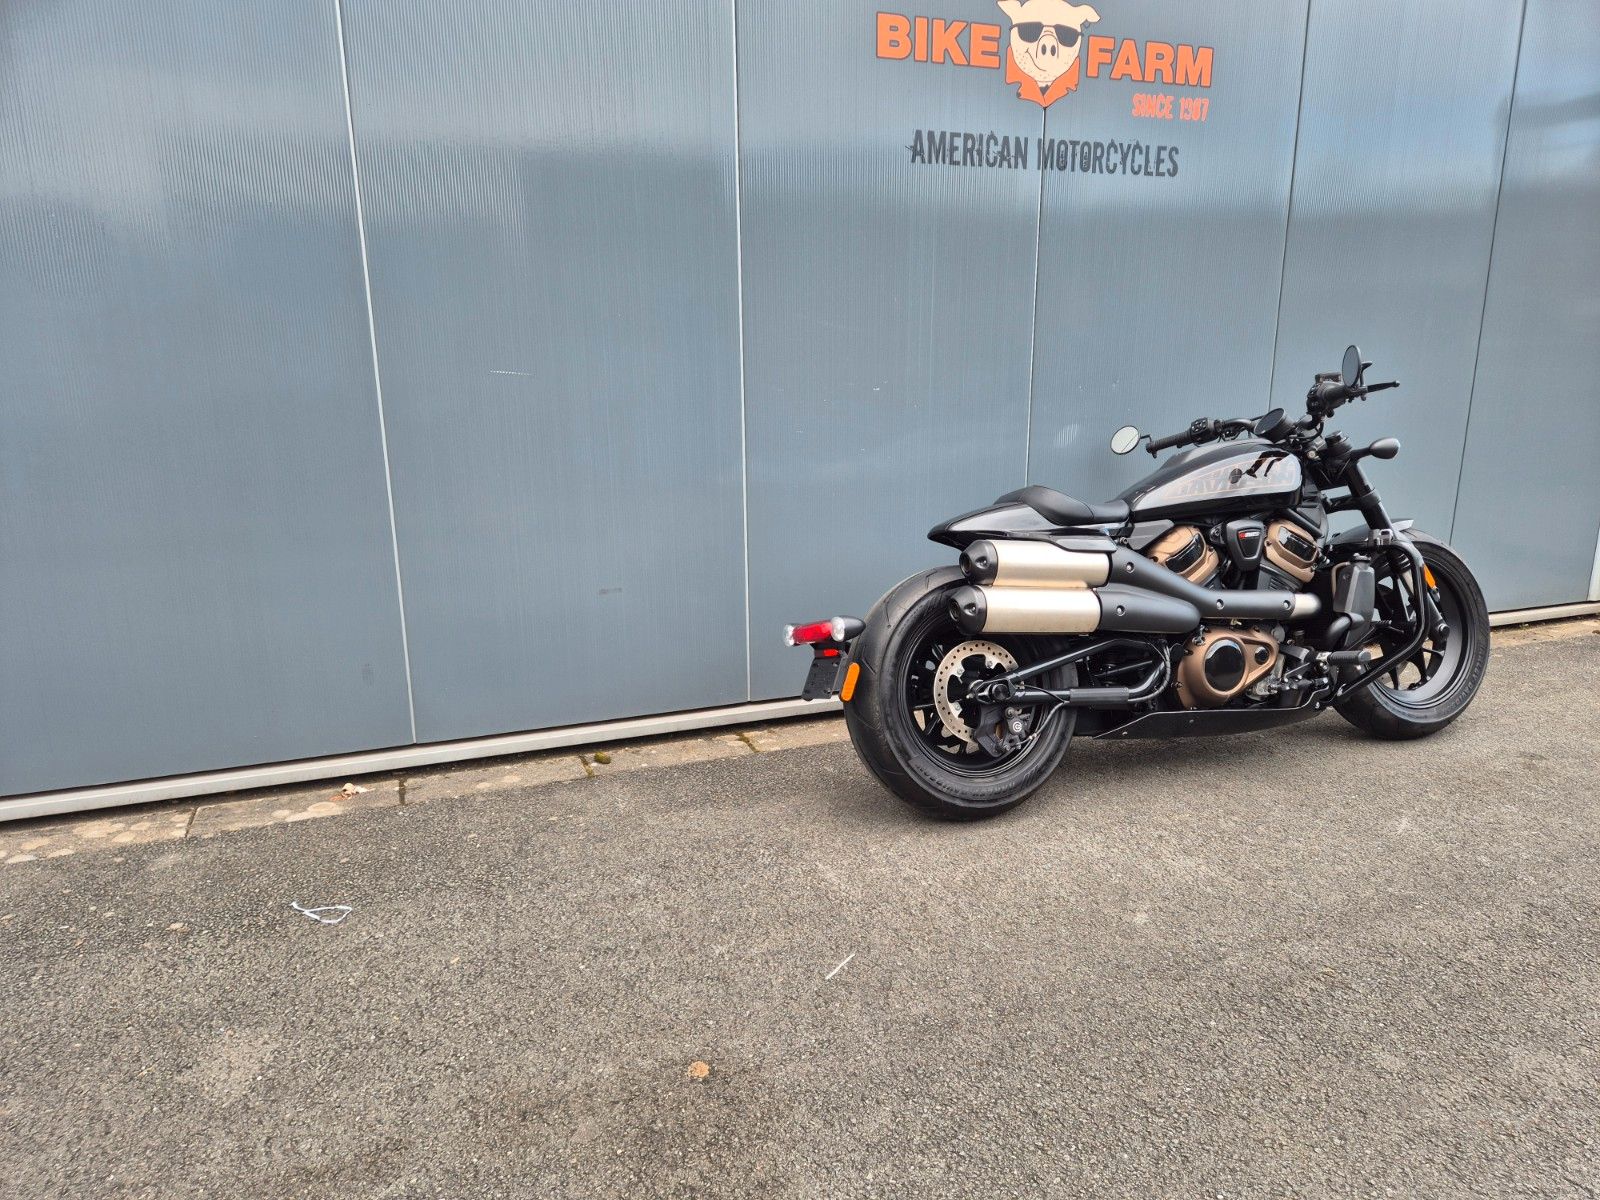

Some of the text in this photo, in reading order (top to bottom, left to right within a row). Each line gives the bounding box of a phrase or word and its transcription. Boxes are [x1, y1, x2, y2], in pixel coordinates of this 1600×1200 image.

[876, 11, 1214, 88] BIKE FARM
[1132, 93, 1174, 119] SINCE
[909, 129, 1180, 177] AMERICAN MOTORCYCLES
